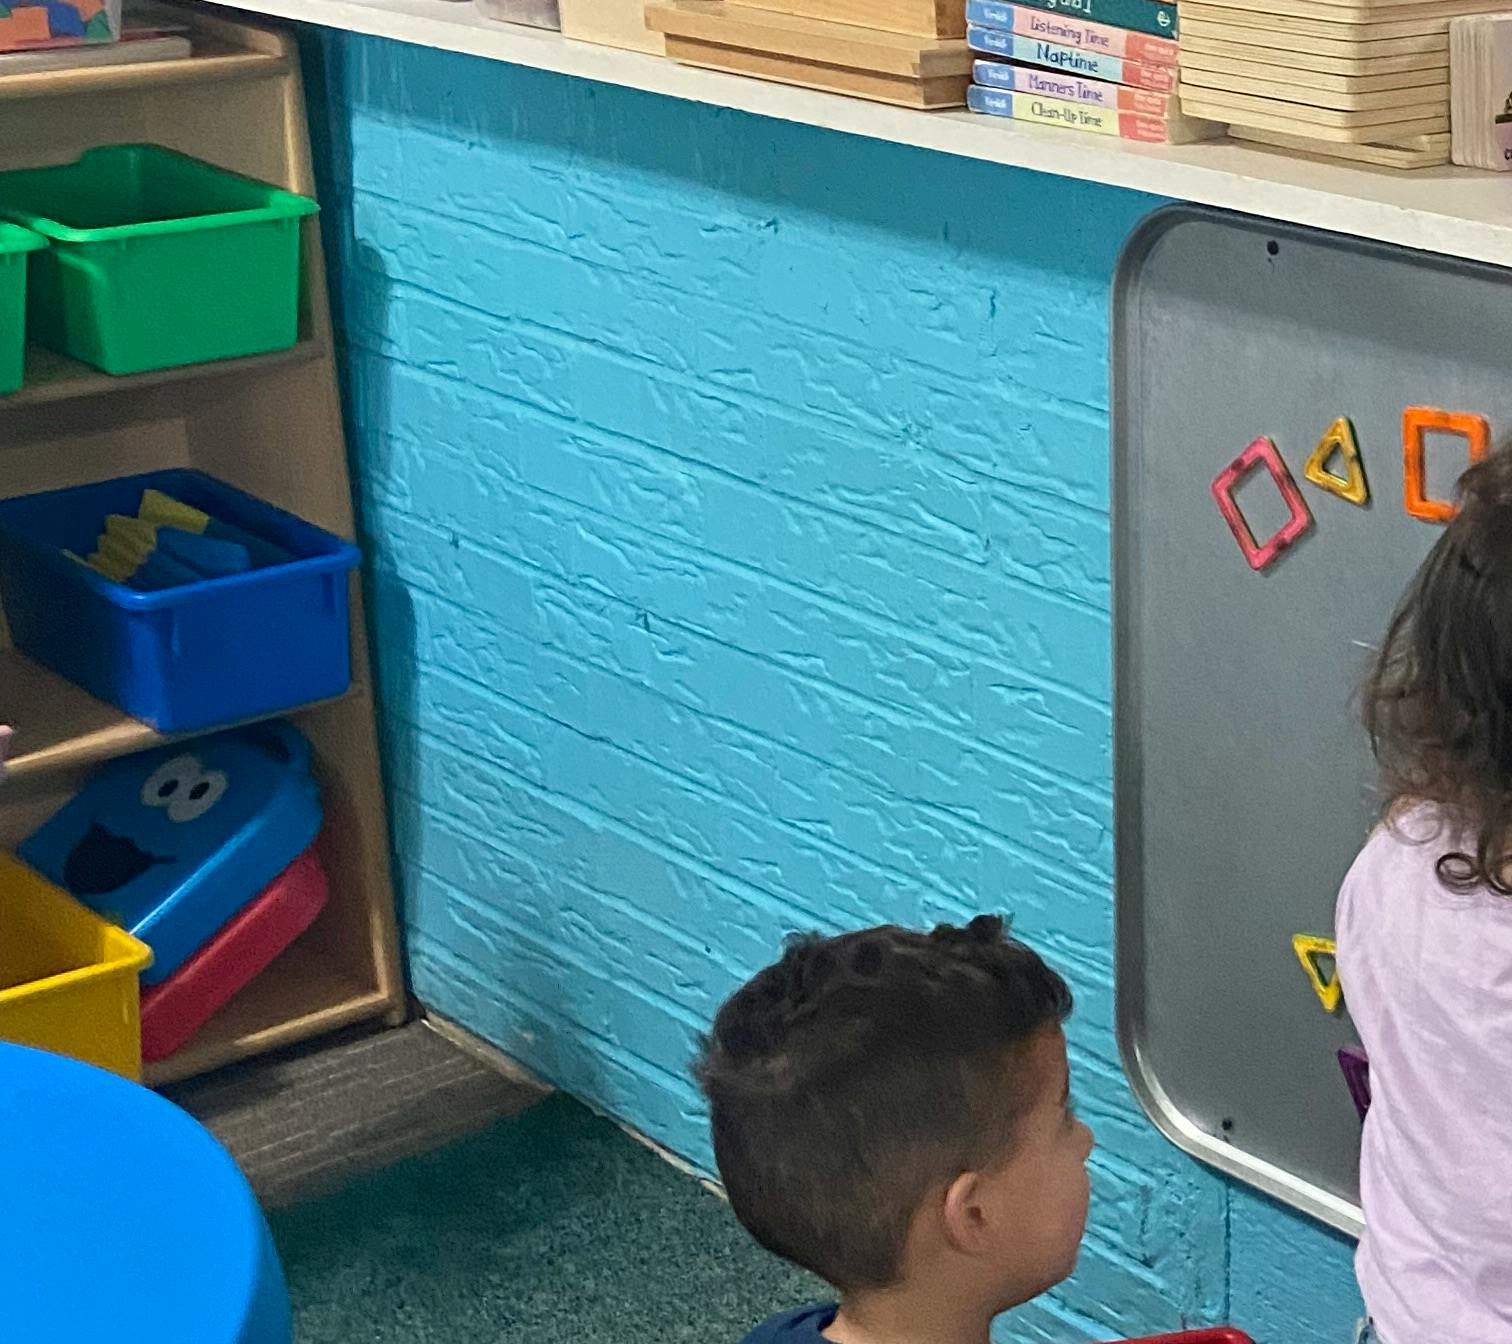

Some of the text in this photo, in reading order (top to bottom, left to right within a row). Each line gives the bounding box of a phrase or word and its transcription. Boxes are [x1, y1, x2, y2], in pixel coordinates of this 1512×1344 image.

[1031, 15, 1081, 44] Listening
[1084, 30, 1109, 47] Time
[1037, 43, 1099, 72] Naptime
[1029, 74, 1074, 96] Manners
[1077, 82, 1103, 102] Time
[1031, 102, 1078, 122] Clean-Up
[1079, 112, 1102, 127] Time
